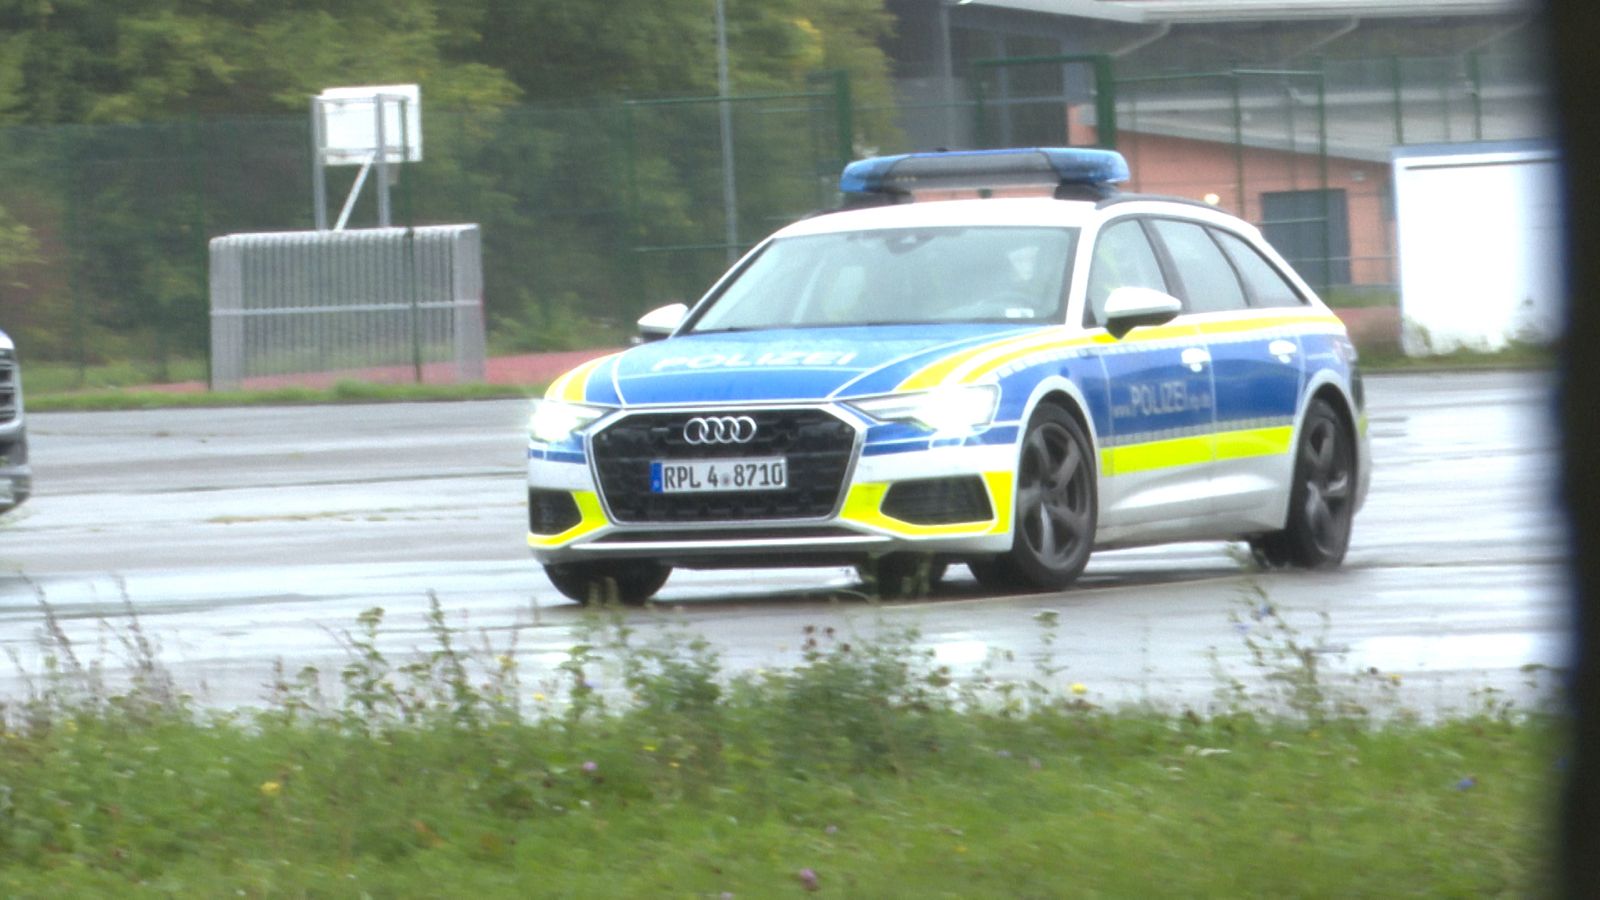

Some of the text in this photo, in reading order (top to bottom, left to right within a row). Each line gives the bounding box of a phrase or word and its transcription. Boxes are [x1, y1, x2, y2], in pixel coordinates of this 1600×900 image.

[652, 351, 857, 371] POLIZEI
[664, 463, 784, 489] RPL 4 8710
